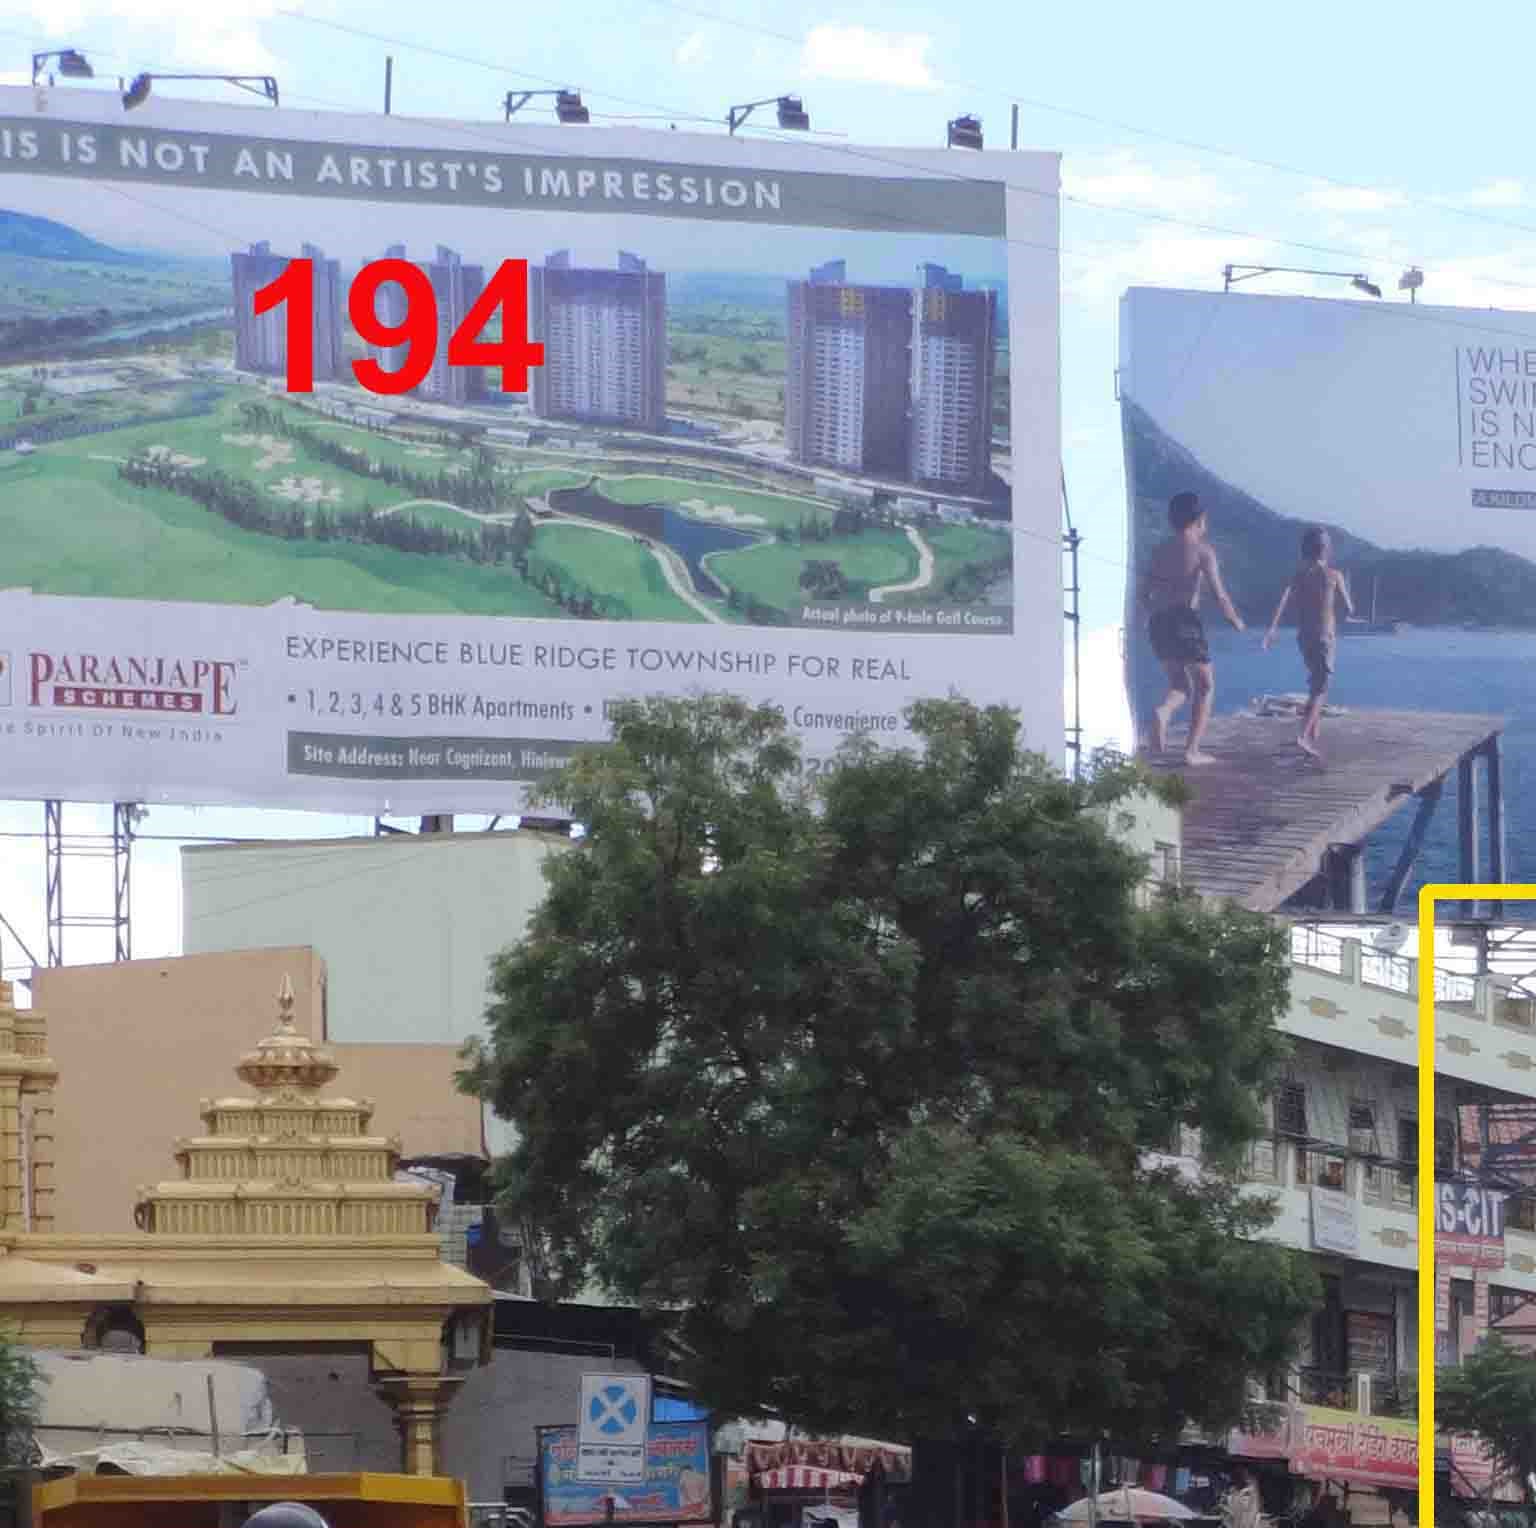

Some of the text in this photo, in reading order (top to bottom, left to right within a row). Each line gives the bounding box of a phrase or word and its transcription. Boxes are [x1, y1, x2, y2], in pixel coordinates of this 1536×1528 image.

[61, 133, 97, 164] IS
[119, 138, 209, 173] NOT
[234, 149, 293, 180] AN
[317, 154, 503, 193] ARTIST'S
[524, 167, 782, 209] IMPRESSION
[1471, 408, 1500, 438] IS
[286, 635, 911, 682] EXPERIENCE BLUE RIDGE TOWNSHIP FOR REAL
[27, 652, 239, 716] PARANJAPE
[62, 688, 194, 710] SCHEMES
[372, 692, 385, 715] 4
[390, 692, 404, 717] &
[410, 692, 423, 718] 5
[427, 692, 467, 717] BHK
[472, 694, 575, 722] Apartments
[793, 705, 898, 732] Convenience
[121, 723, 162, 740] New
[303, 743, 335, 764] Site
